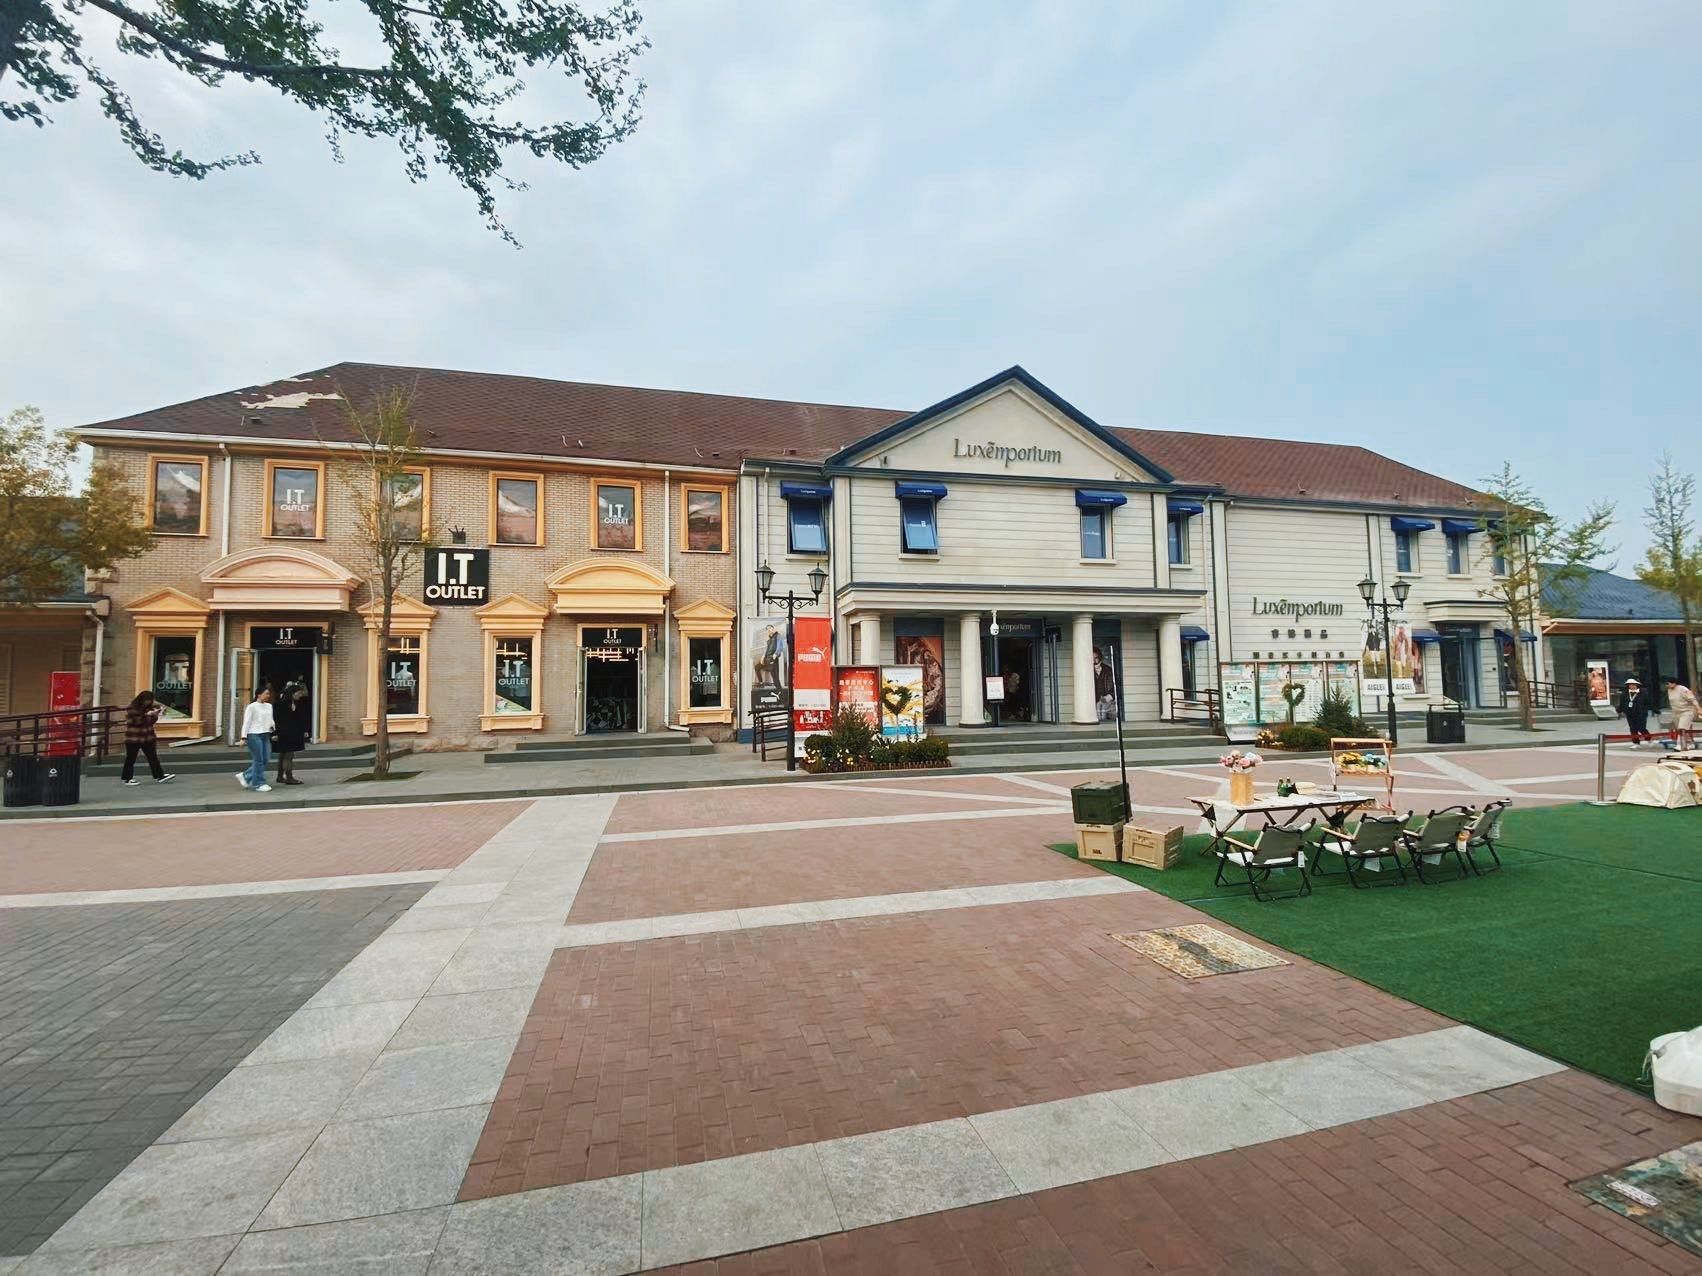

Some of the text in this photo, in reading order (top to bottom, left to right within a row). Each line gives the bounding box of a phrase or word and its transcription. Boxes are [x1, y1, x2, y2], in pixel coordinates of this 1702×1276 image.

[287, 489, 304, 504] I.T
[280, 504, 309, 512] OUTLET
[608, 504, 624, 518] I.T
[603, 517, 629, 525] OUTLET
[437, 552, 474, 585] I.T
[425, 585, 486, 599] OUTLET
[280, 628, 293, 640] I.T
[606, 628, 619, 639] I.T
[503, 660, 524, 678] I.T
[697, 659, 714, 676] I.T
[498, 677, 529, 686] OUTLET
[692, 675, 719, 683] OUTLET
[156, 681, 193, 690] OUTLET
